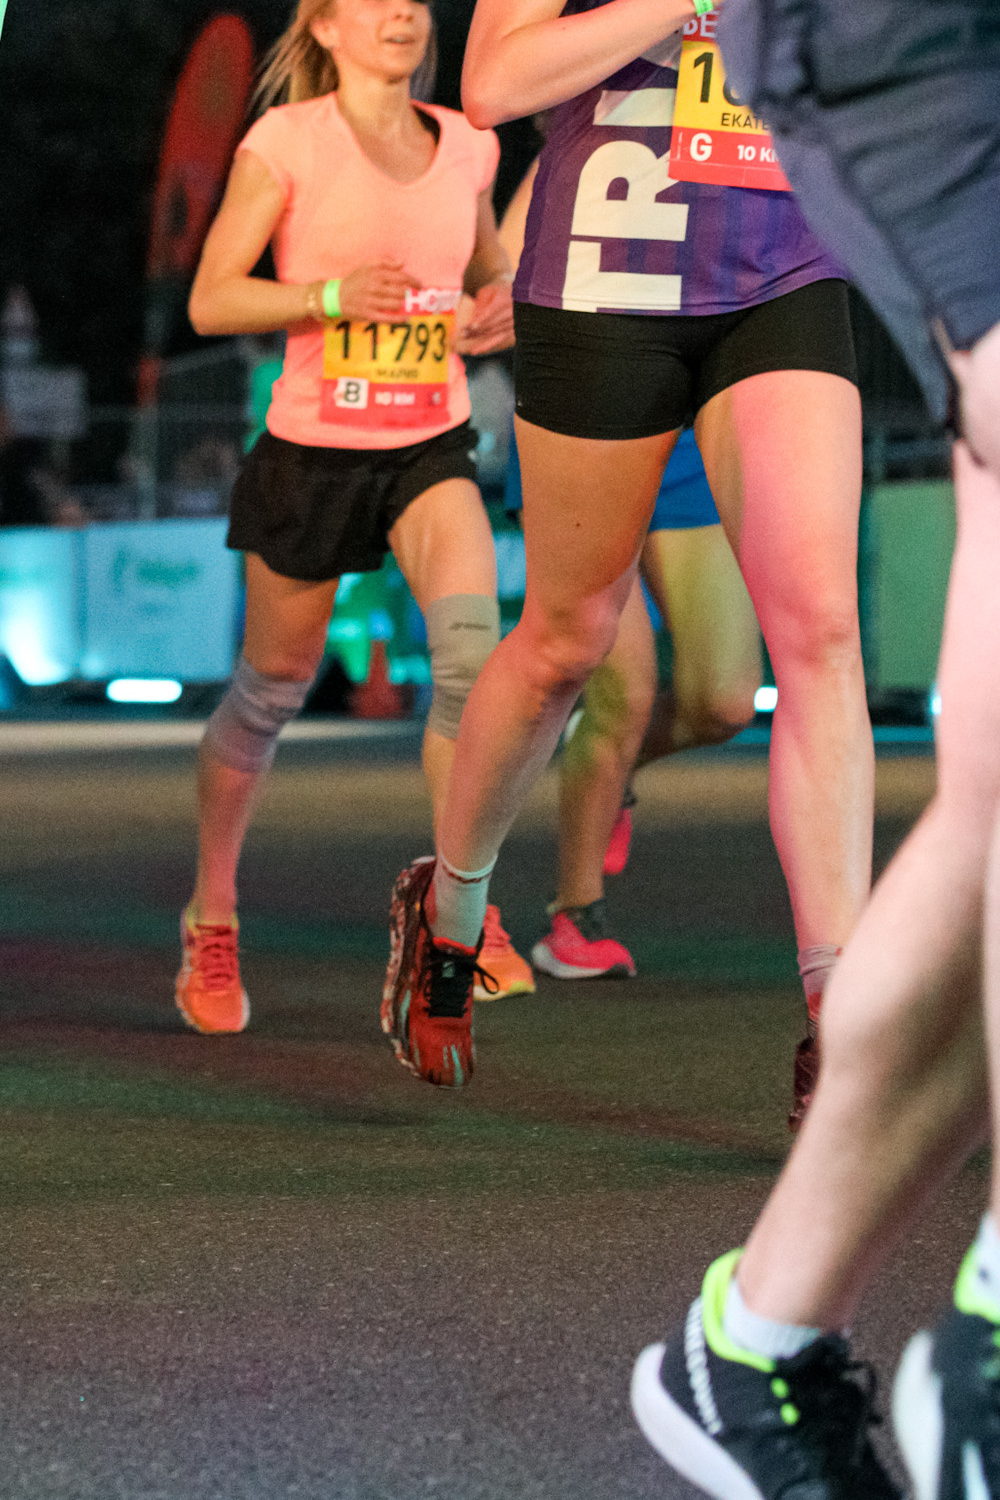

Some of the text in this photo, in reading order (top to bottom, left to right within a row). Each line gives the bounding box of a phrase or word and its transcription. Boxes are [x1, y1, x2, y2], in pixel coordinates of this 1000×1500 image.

[690, 133, 713, 162] G
[737, 144, 756, 161] 10
[335, 320, 446, 362] 11793
